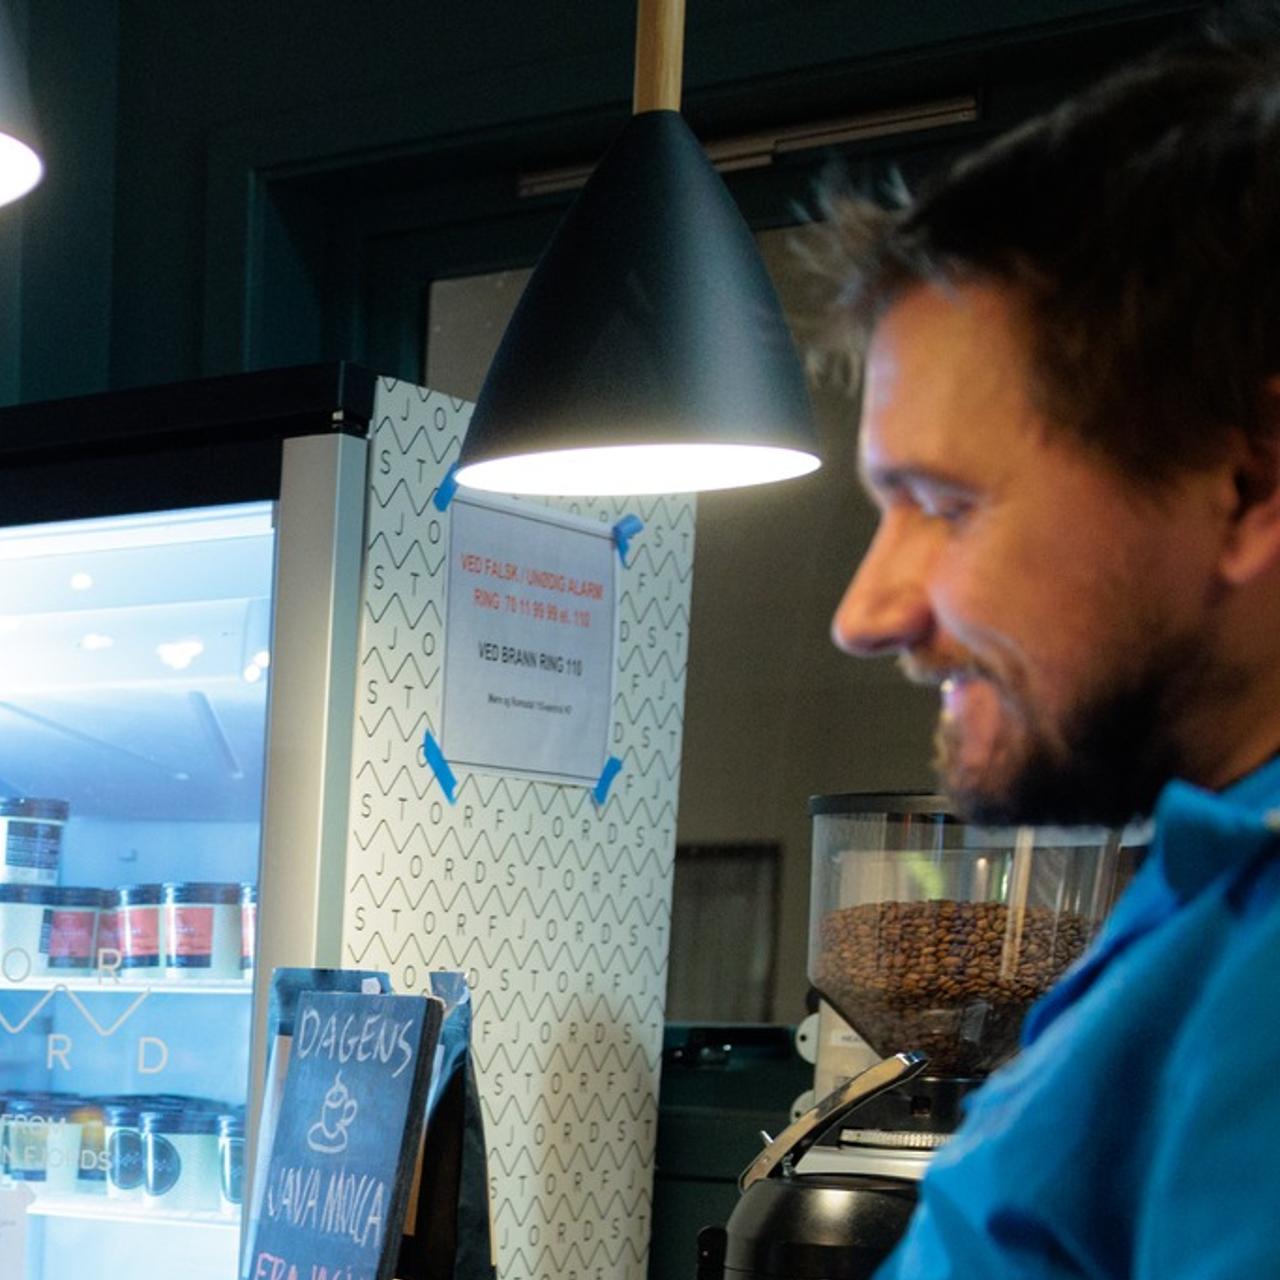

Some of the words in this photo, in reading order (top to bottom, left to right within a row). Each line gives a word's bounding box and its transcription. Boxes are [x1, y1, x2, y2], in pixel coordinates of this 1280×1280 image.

[478, 640, 499, 662] VED
[501, 646, 537, 669] BRANN
[539, 652, 564, 674] RING
[298, 1008, 414, 1079] DAGENS
[2, 1112, 67, 1135] FROM
[24, 1145, 113, 1171] FJODS
